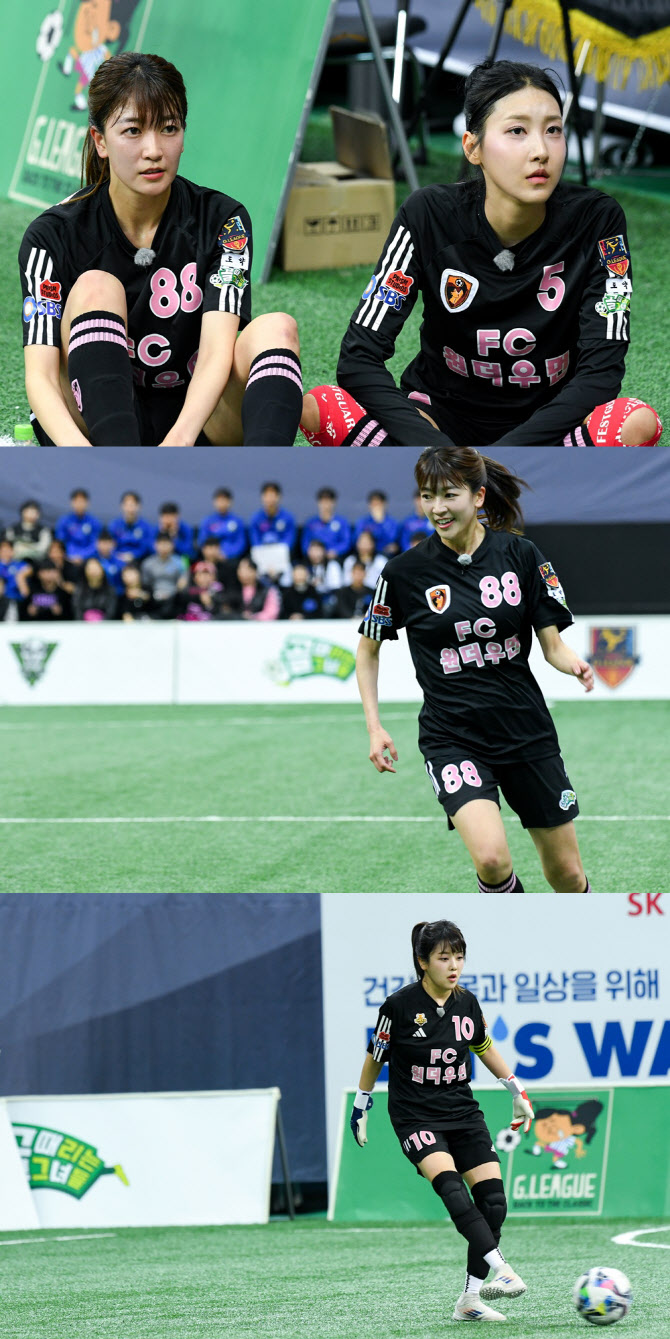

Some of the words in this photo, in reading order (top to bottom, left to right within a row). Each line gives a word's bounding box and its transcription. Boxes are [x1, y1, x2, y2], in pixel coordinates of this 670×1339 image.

[149, 262, 203, 319] 88
[375, 285, 406, 310] SBS
[537, 261, 566, 312] 5
[37, 300, 62, 319] SBS
[476, 327, 537, 357] FC
[442, 345, 570, 387] 원더우먼
[479, 571, 522, 609] 88
[371, 614, 393, 627] SBS
[454, 617, 497, 642] FC
[440, 634, 521, 675] 원더우먼
[441, 760, 483, 794] 88
[628, 893, 664, 916] SK
[515, 971, 597, 1003] 일상을
[606, 969, 659, 1000] 위해
[452, 1016, 475, 1041] 10
[430, 1048, 458, 1064] FC
[411, 1062, 467, 1085] 원더우먼
[408, 1130, 437, 1152] 10
[512, 1173, 598, 1200] G.LEAGUE
